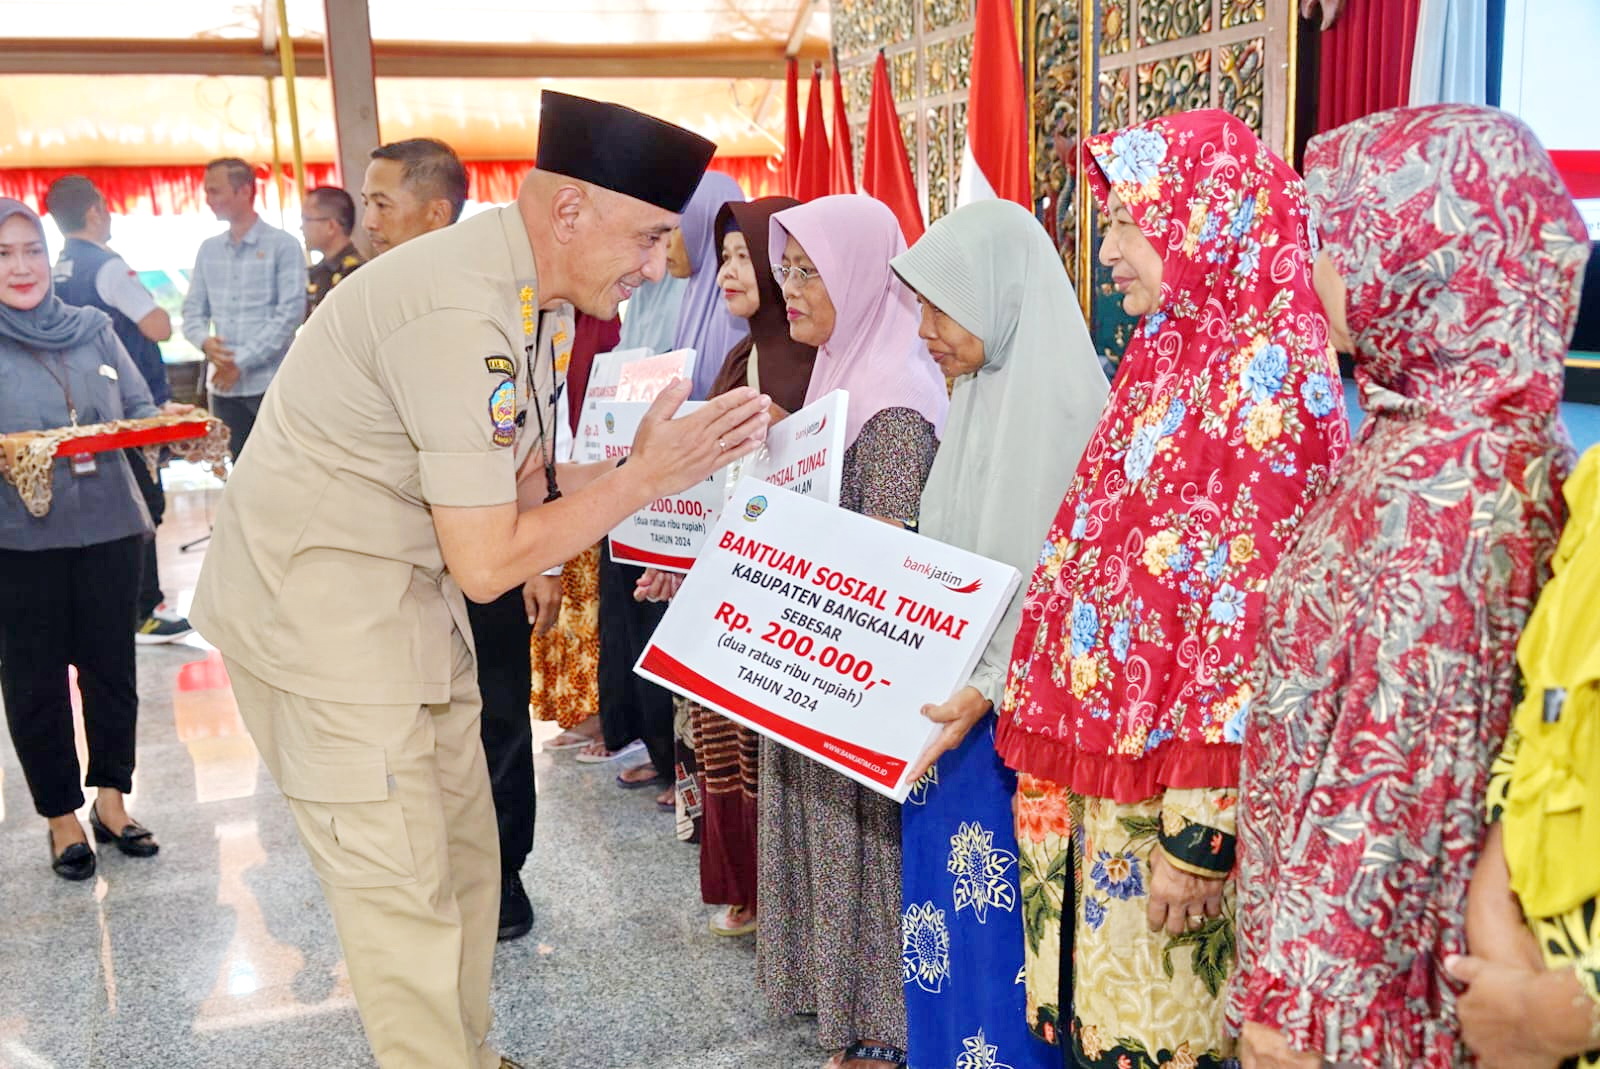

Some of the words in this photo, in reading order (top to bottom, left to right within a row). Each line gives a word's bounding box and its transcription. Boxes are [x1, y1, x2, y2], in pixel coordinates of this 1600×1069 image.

[605, 445, 632, 458] BANT
[797, 448, 827, 477] TUNAI
[650, 498, 713, 520] 200.000,-
[650, 532, 673, 545] TAHUN
[674, 536, 691, 547] 2024
[667, 519, 680, 530] ribu
[681, 521, 706, 535] rupiah)
[718, 530, 813, 580] BANTUAN
[811, 566, 888, 611] SOSIAL
[895, 596, 969, 641] TUNAI
[903, 555, 963, 587] bankjatim
[731, 562, 823, 609] KABUPATEN
[822, 598, 925, 650] BANGKALAN
[780, 607, 843, 642] SEBESAR
[713, 601, 753, 635] Rp.
[760, 621, 892, 691] 200.000,-
[717, 632, 747, 654] (dua
[747, 648, 783, 670] ratus
[783, 662, 809, 683] ribu
[812, 675, 864, 709] rupiah)
[736, 665, 784, 696] TAHUN
[783, 687, 819, 713] 2024
